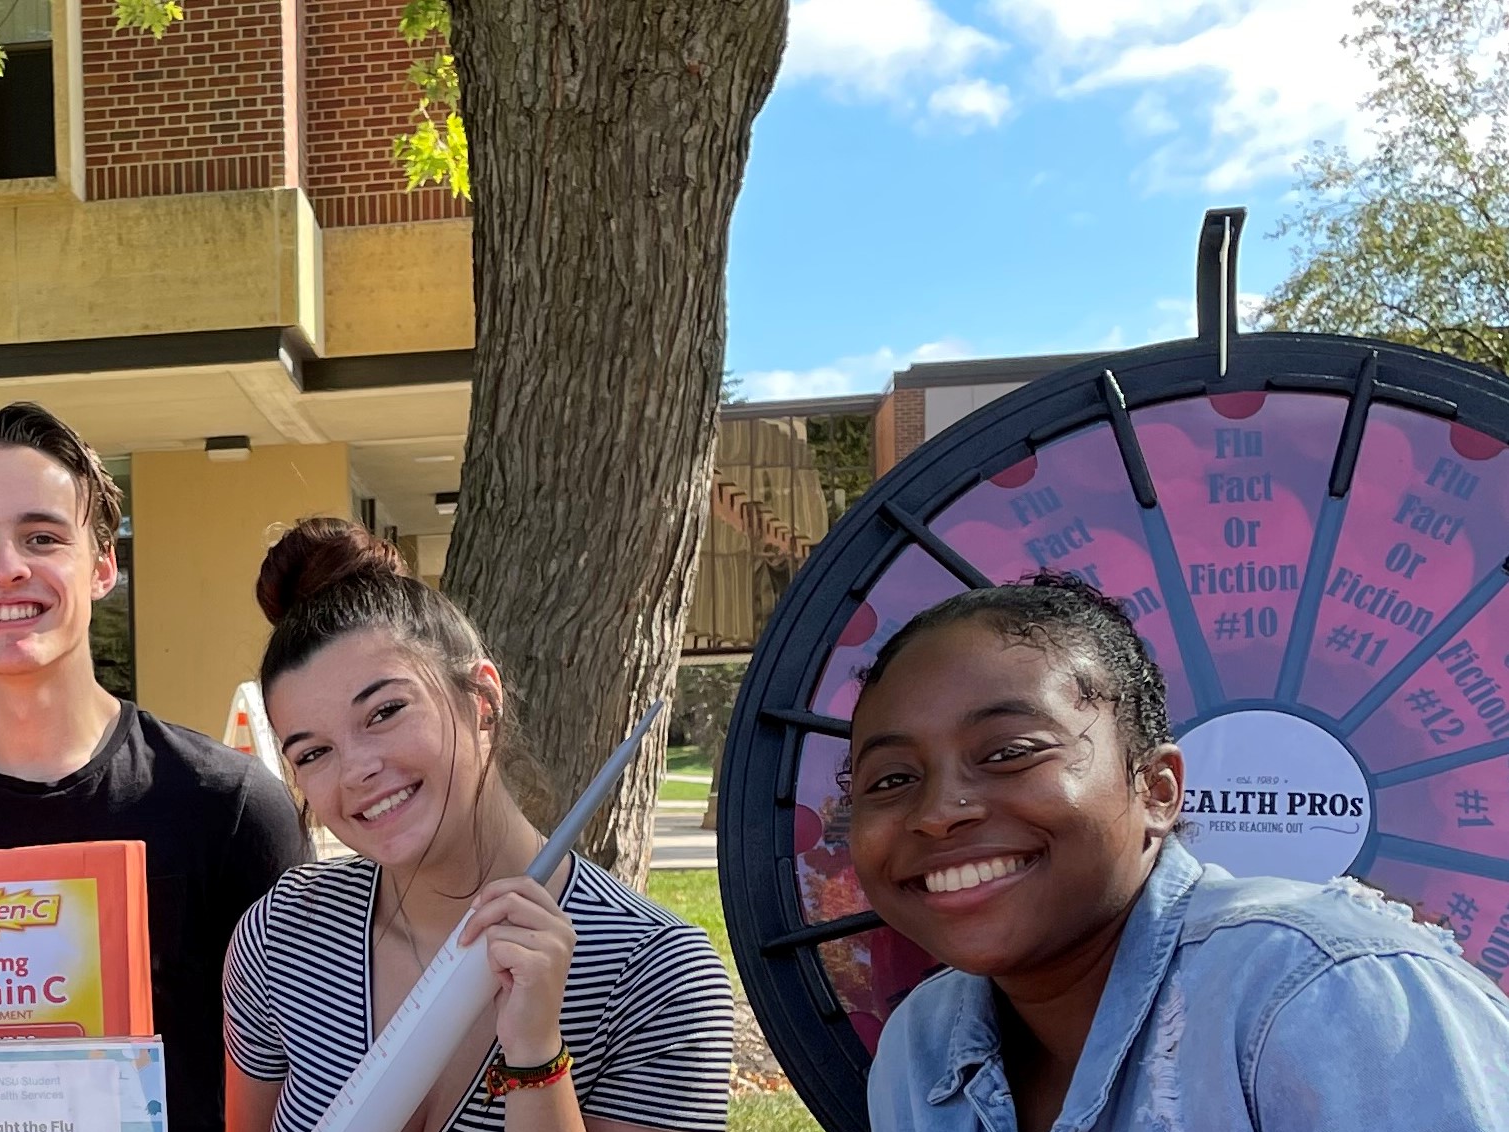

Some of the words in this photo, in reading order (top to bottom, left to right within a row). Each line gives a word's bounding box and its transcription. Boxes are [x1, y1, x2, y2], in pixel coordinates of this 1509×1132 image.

[1214, 428, 1263, 459] Flu
[1207, 472, 1273, 504] Fact
[1425, 457, 1480, 501] Flu
[1010, 486, 1063, 527] Flu
[1393, 492, 1465, 546] Fact
[1223, 516, 1261, 548] Or
[1189, 561, 1299, 595] Fiction
[1385, 542, 1427, 580] Or
[1325, 566, 1434, 636] Fiction
[1214, 606, 1278, 640] #10
[1325, 624, 1389, 667] #11
[1405, 688, 1465, 744] #12
[1181, 790, 1278, 814] EALTH
[1287, 792, 1364, 818] PROs
[1455, 790, 1495, 828] #1
[1209, 821, 1236, 832] PEERS
[1239, 822, 1283, 834] REACHING
[1286, 822, 1303, 834] OUT
[43, 976, 68, 1004] C
